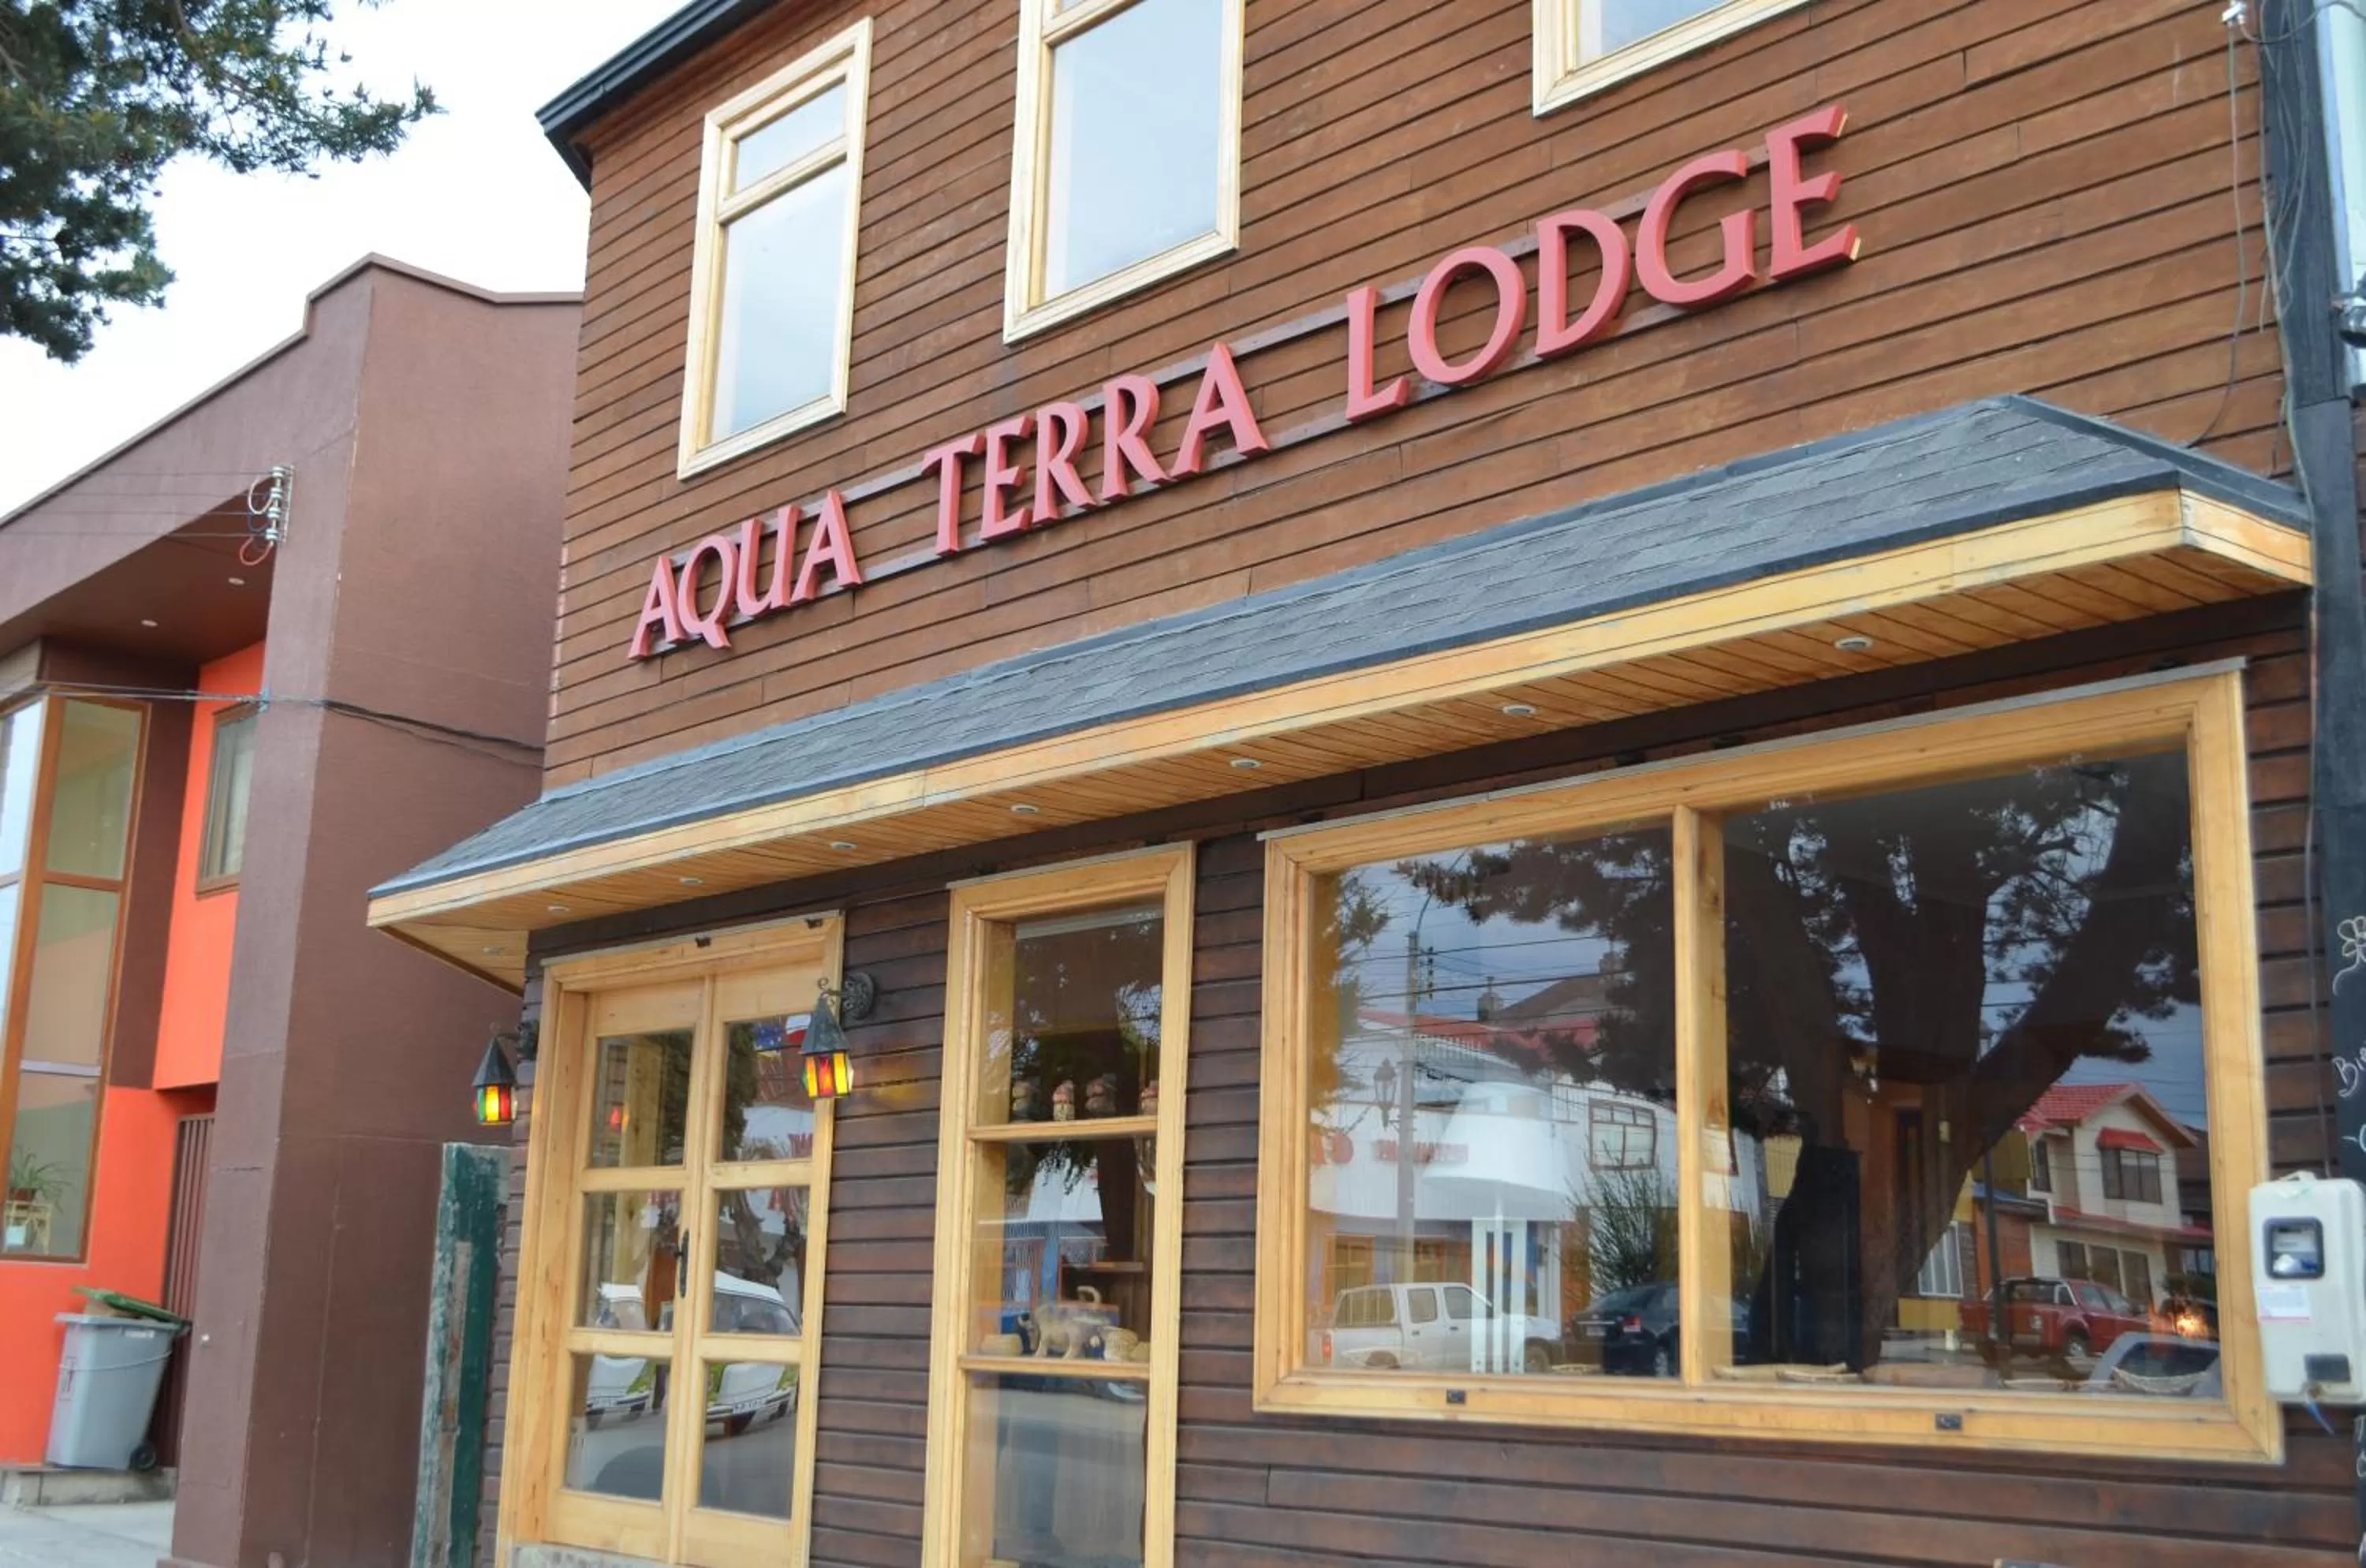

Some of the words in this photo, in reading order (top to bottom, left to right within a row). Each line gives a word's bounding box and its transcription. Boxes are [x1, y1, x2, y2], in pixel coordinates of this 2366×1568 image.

[629, 491, 862, 660] AQUA
[921, 342, 1269, 554] TERRA
[1346, 106, 1861, 421] LODGE
